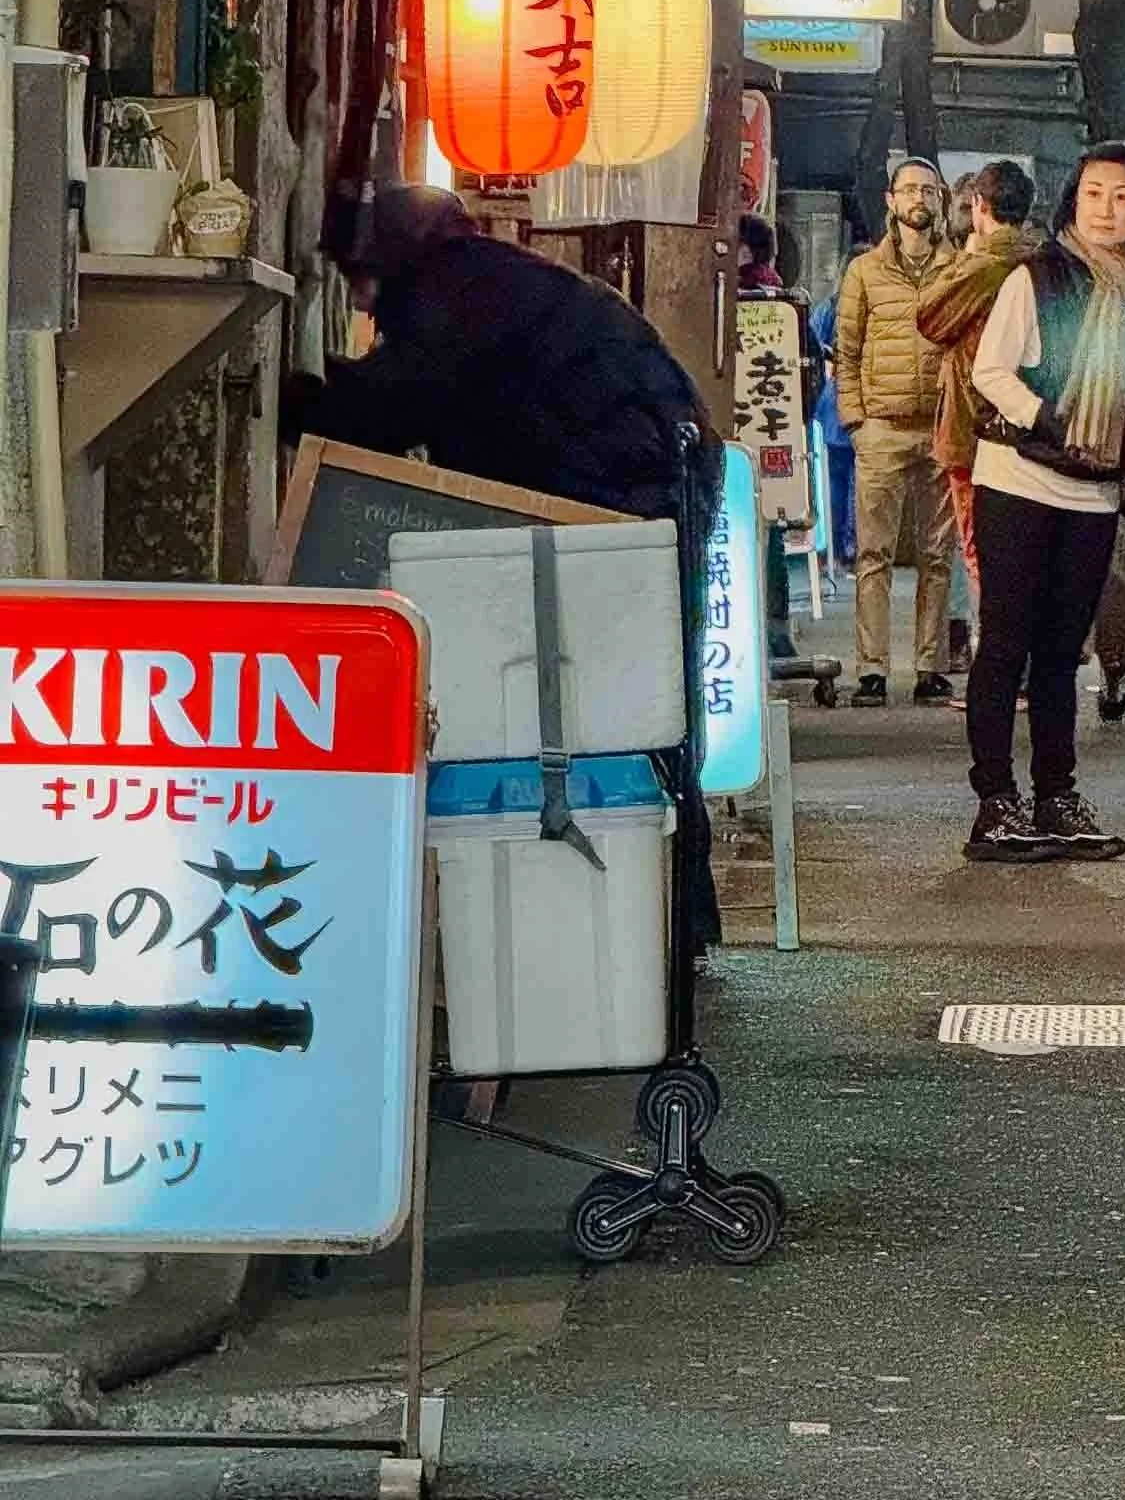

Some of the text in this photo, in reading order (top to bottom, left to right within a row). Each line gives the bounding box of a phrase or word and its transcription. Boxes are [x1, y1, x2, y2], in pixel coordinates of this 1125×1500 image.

[767, 40, 847, 53] SUNTORY
[0, 647, 343, 752] KIRIN
[42, 777, 274, 825] キリンビール
[0, 846, 335, 976] 石の花
